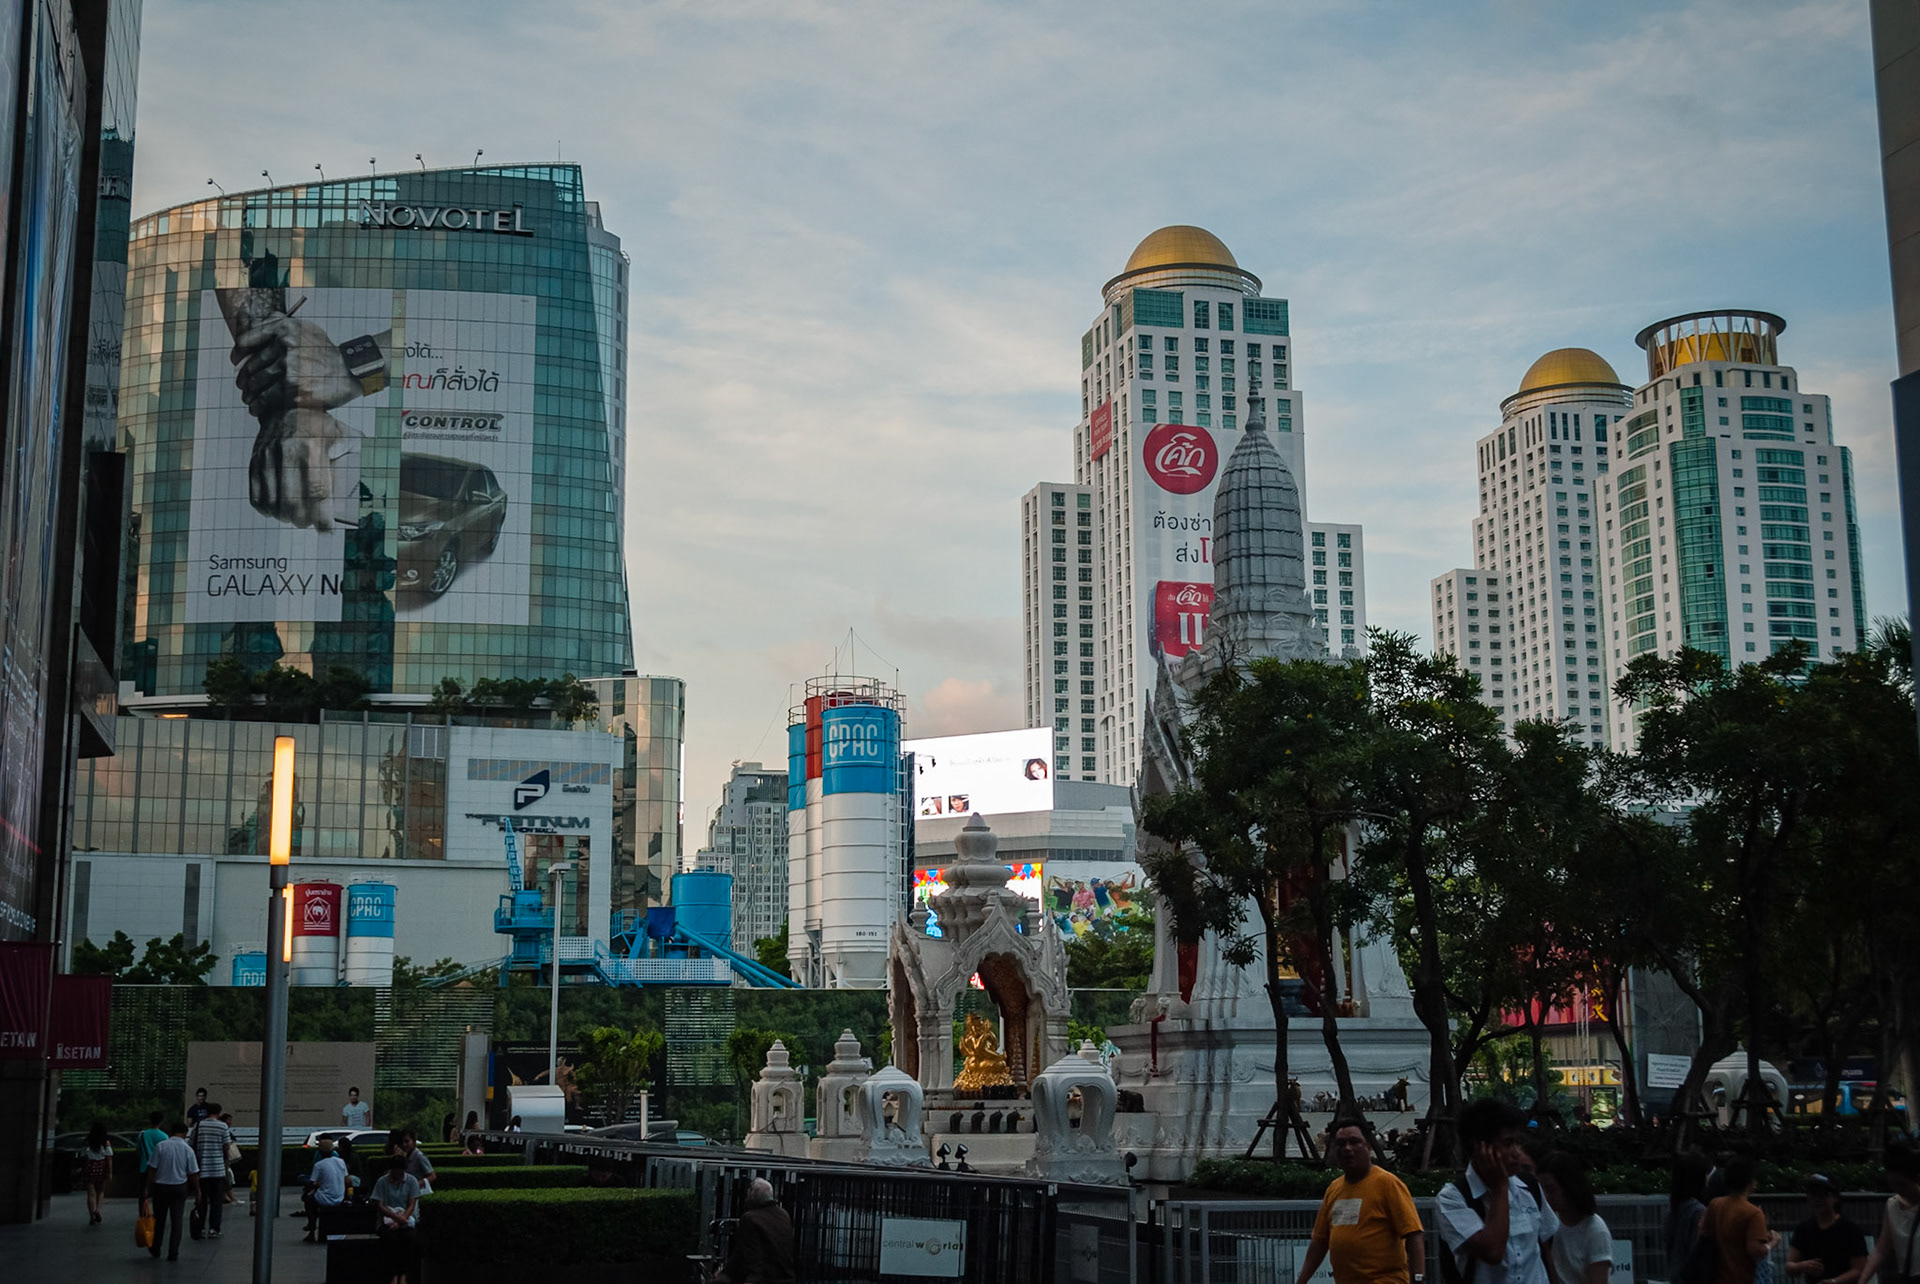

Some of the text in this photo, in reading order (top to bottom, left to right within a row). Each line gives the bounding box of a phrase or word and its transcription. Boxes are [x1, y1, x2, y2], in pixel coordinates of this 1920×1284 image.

[359, 198, 535, 237] NOVOTEL
[405, 416, 502, 431] CONTROL
[209, 554, 288, 573] Samsung
[207, 573, 344, 597] GALAXY N
[829, 724, 878, 758] CPAC
[350, 896, 382, 917] CPAC
[56, 1042, 102, 1060] ISETAN
